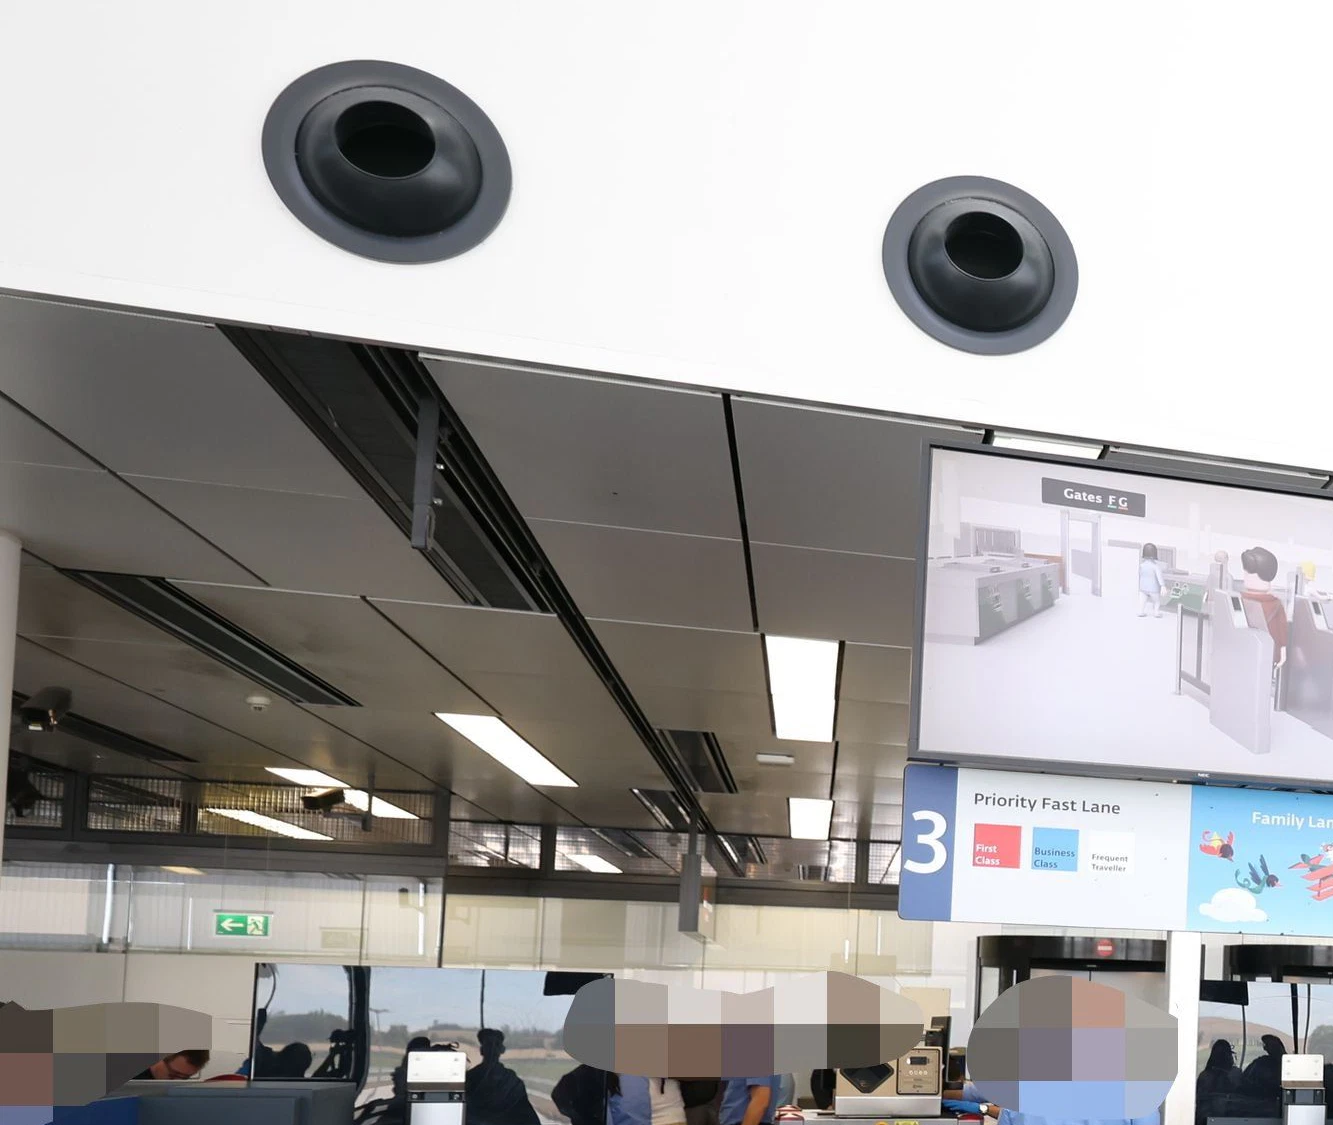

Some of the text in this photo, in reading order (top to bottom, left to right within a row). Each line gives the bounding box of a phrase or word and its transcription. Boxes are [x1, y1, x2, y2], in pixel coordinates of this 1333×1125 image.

[1064, 488, 1102, 504] Gates
[974, 792, 1121, 815] Priority Fast Lane
[1252, 811, 1304, 831] Family
[904, 810, 947, 874] 3
[975, 843, 998, 854] First
[1034, 847, 1076, 858] Business
[975, 856, 1001, 866] Class
[1034, 859, 1058, 869] Class
[1091, 853, 1128, 864] Frequent
[1091, 863, 1127, 873] Traveller
